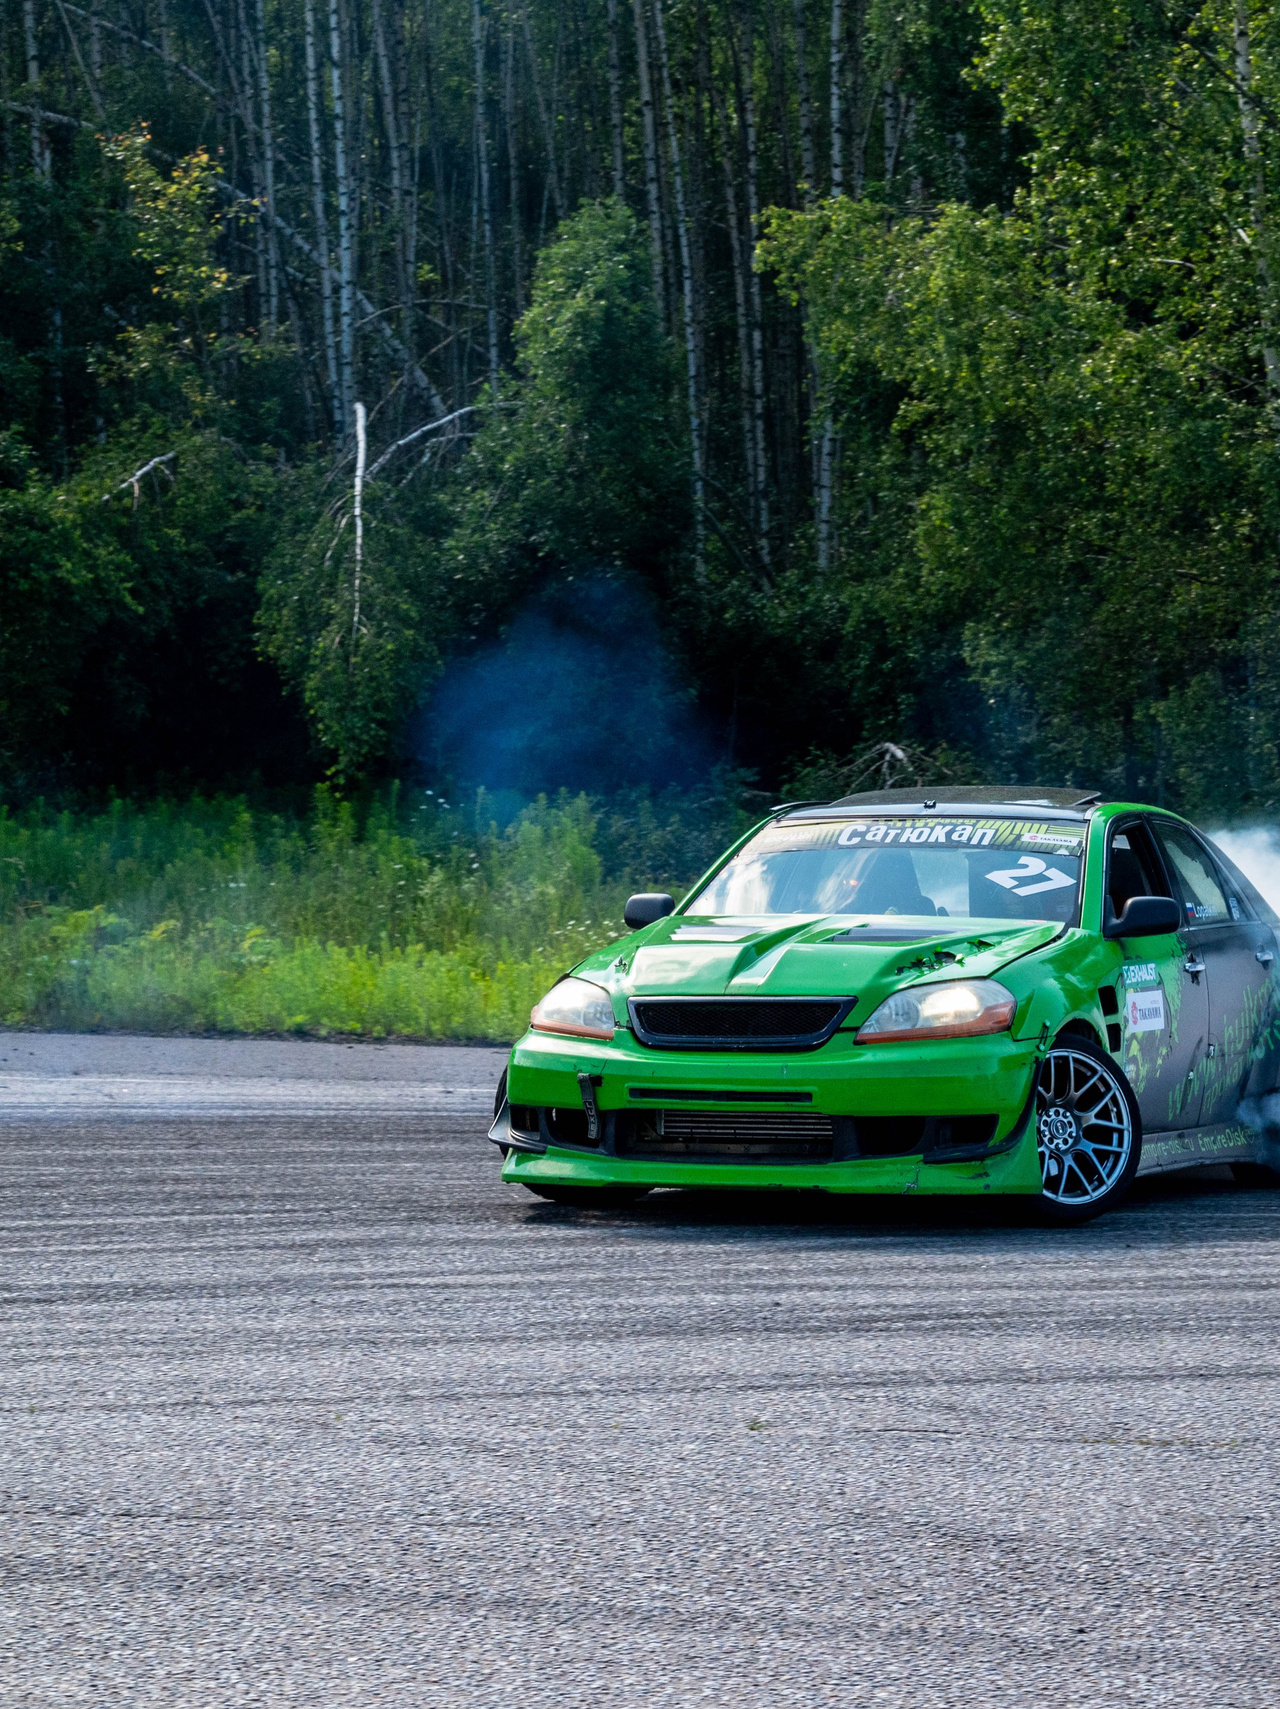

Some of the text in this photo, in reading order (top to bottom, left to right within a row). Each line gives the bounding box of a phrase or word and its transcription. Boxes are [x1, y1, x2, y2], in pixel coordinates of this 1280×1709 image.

[837, 825, 996, 846] Сатюкап
[985, 855, 1077, 897] 27
[1138, 1006, 1162, 1021] TAKAYAMA
